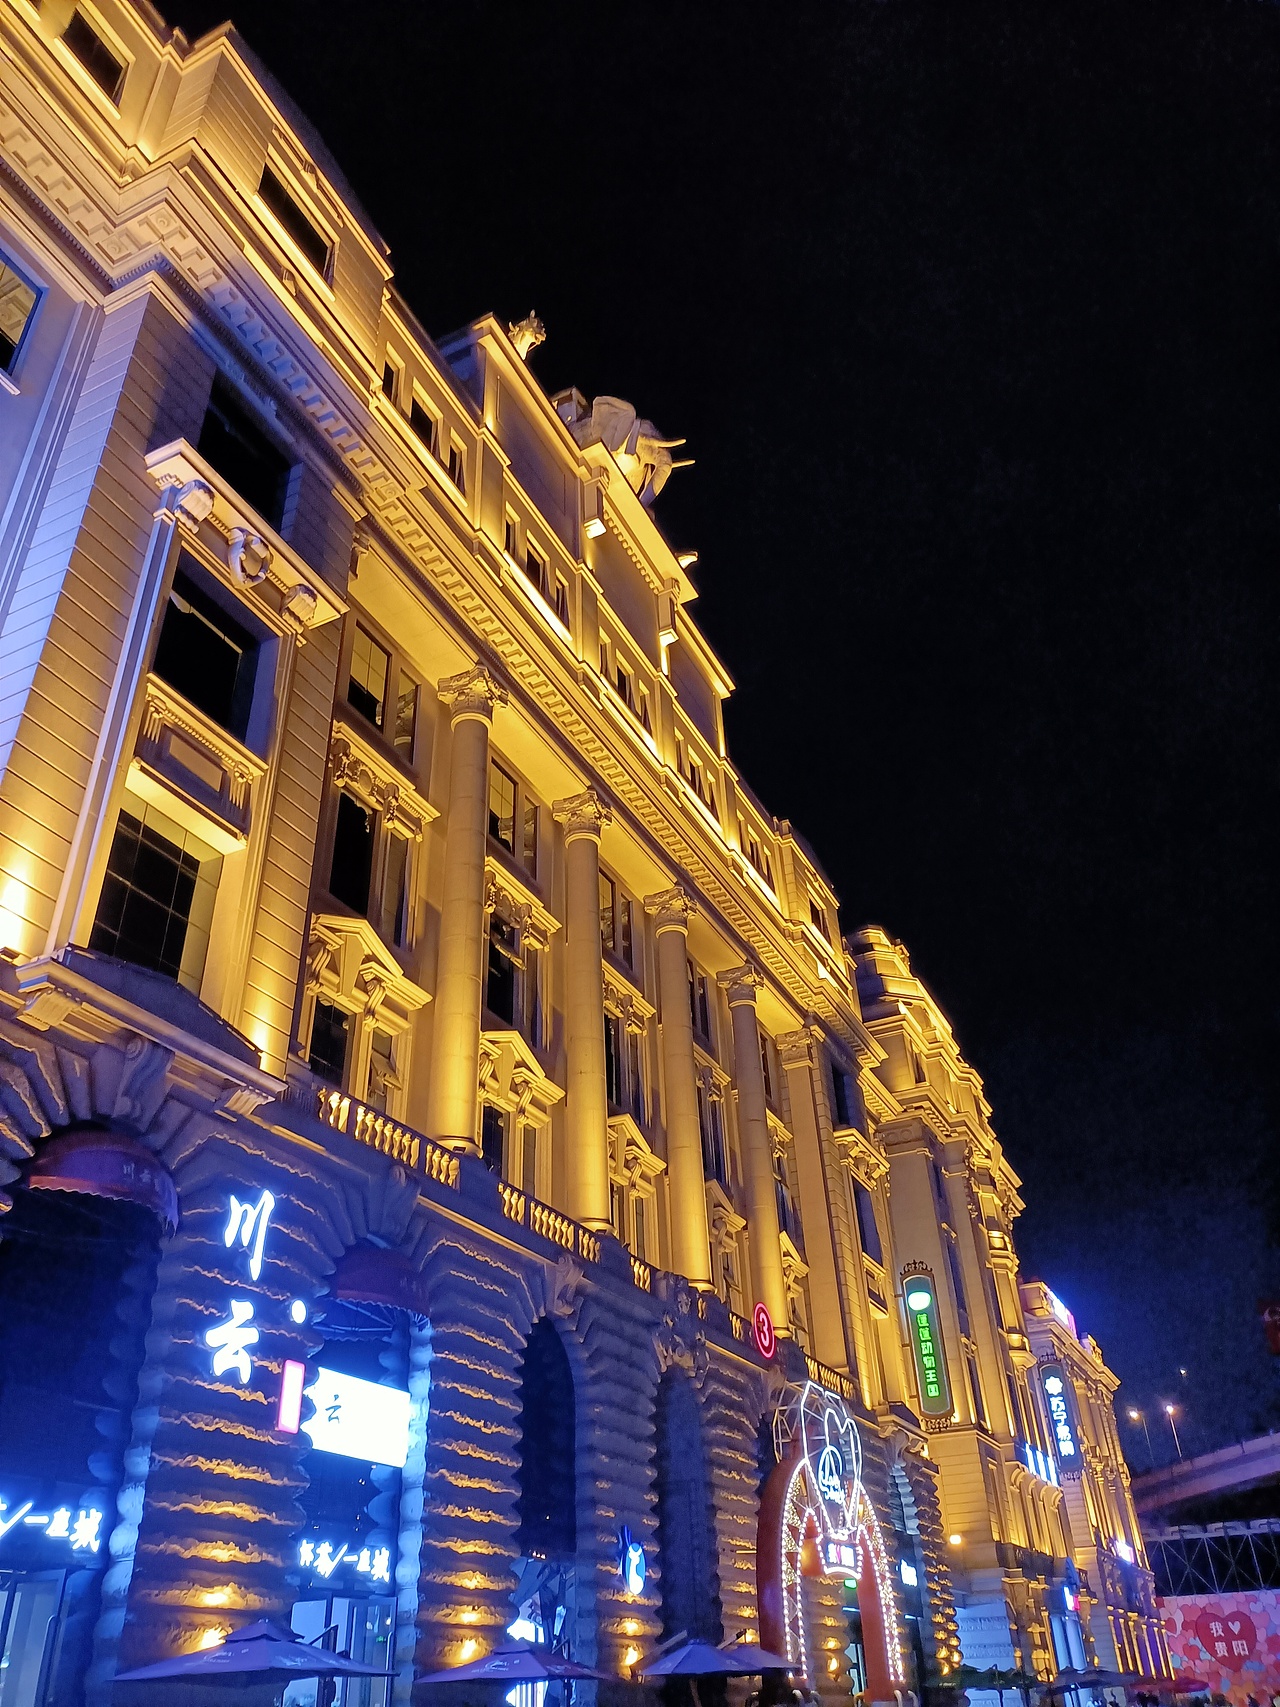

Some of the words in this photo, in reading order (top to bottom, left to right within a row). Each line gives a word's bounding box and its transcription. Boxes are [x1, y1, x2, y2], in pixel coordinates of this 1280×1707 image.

[206, 1190, 275, 1384] 川云
[1209, 1621, 1225, 1637] 我
[1214, 1640, 1249, 1657] 贵阳
